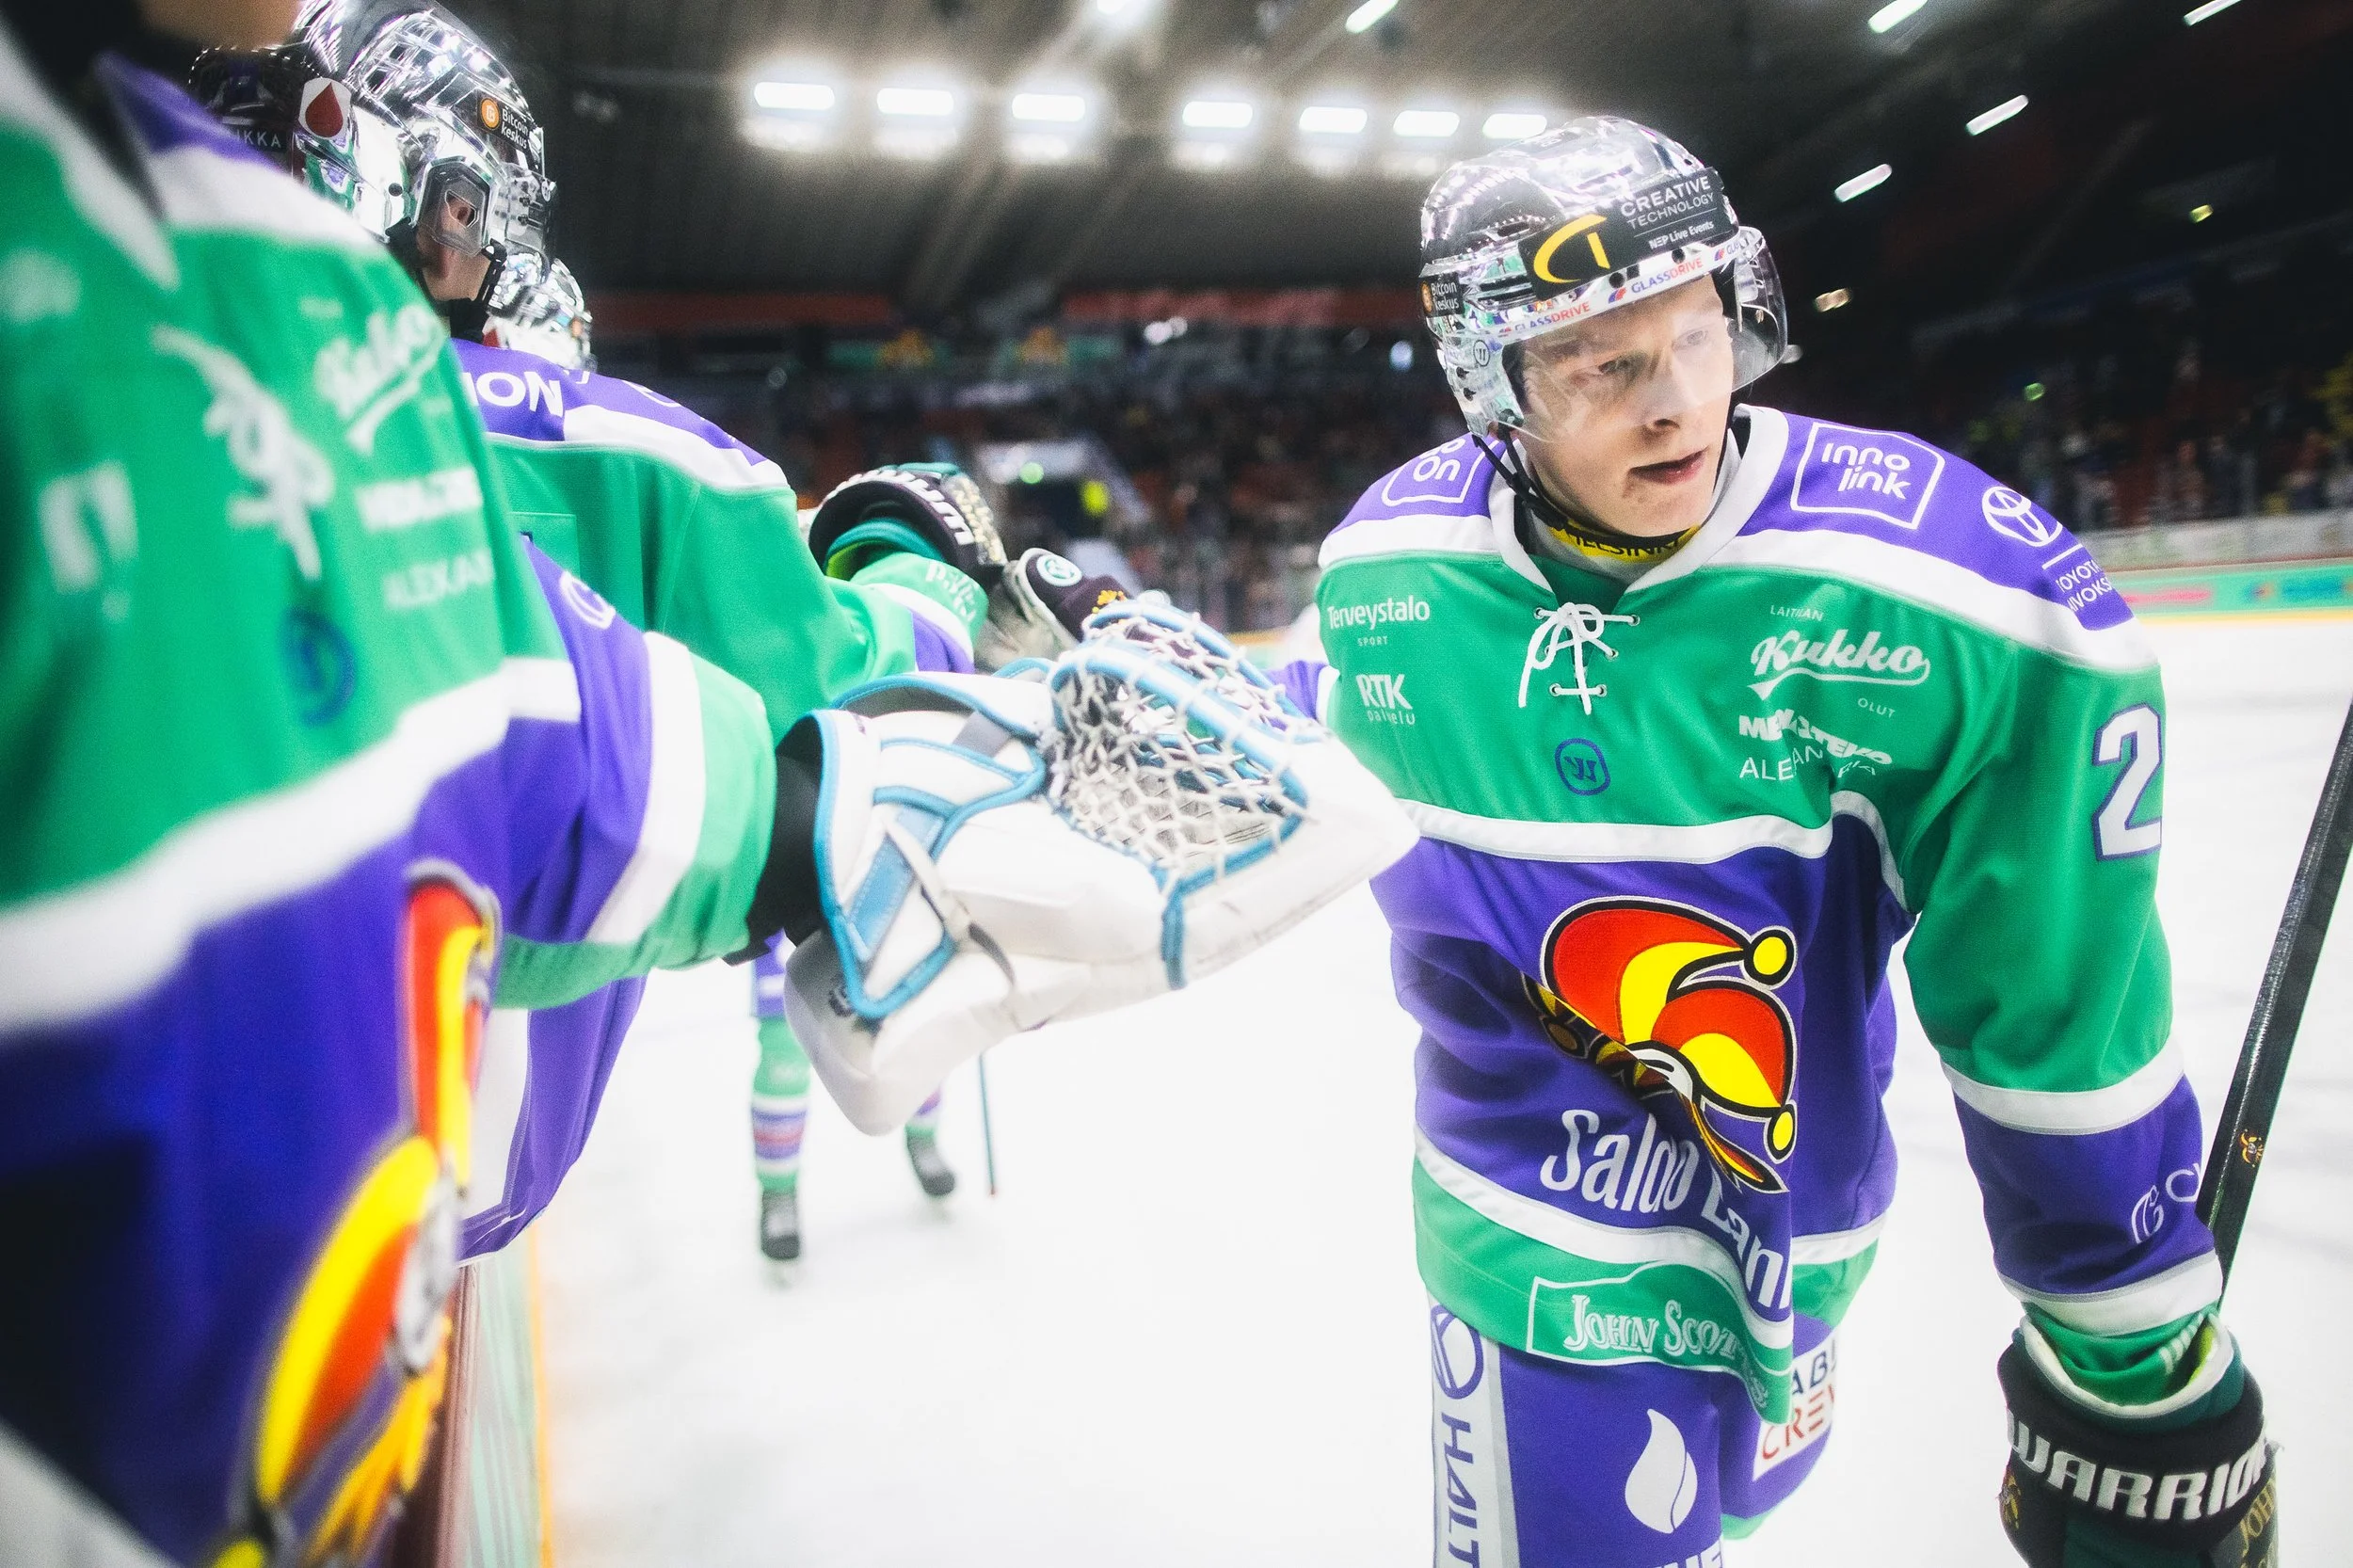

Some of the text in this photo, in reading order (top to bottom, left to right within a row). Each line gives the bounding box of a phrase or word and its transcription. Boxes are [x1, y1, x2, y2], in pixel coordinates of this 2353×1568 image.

[501, 121, 528, 150] keskus
[502, 108, 529, 136] Bitcoin
[1620, 175, 1711, 217] CREATIVE
[1626, 191, 1715, 231] TECHNOLOGY
[1648, 220, 1715, 250] NEP Live Events
[1431, 281, 1458, 296] Bitcoin
[1631, 257, 1704, 294] GLASSDRIVE
[1837, 465, 1912, 500] link
[1327, 595, 1431, 631] Terveystalo
[1357, 635, 1388, 647] SPORT
[1750, 629, 1929, 687] Kukko
[1356, 674, 1413, 710] RTK
[1857, 697, 1896, 718] OLUT
[2091, 701, 2163, 861] 2
[1563, 1294, 1659, 1353] JOHN
